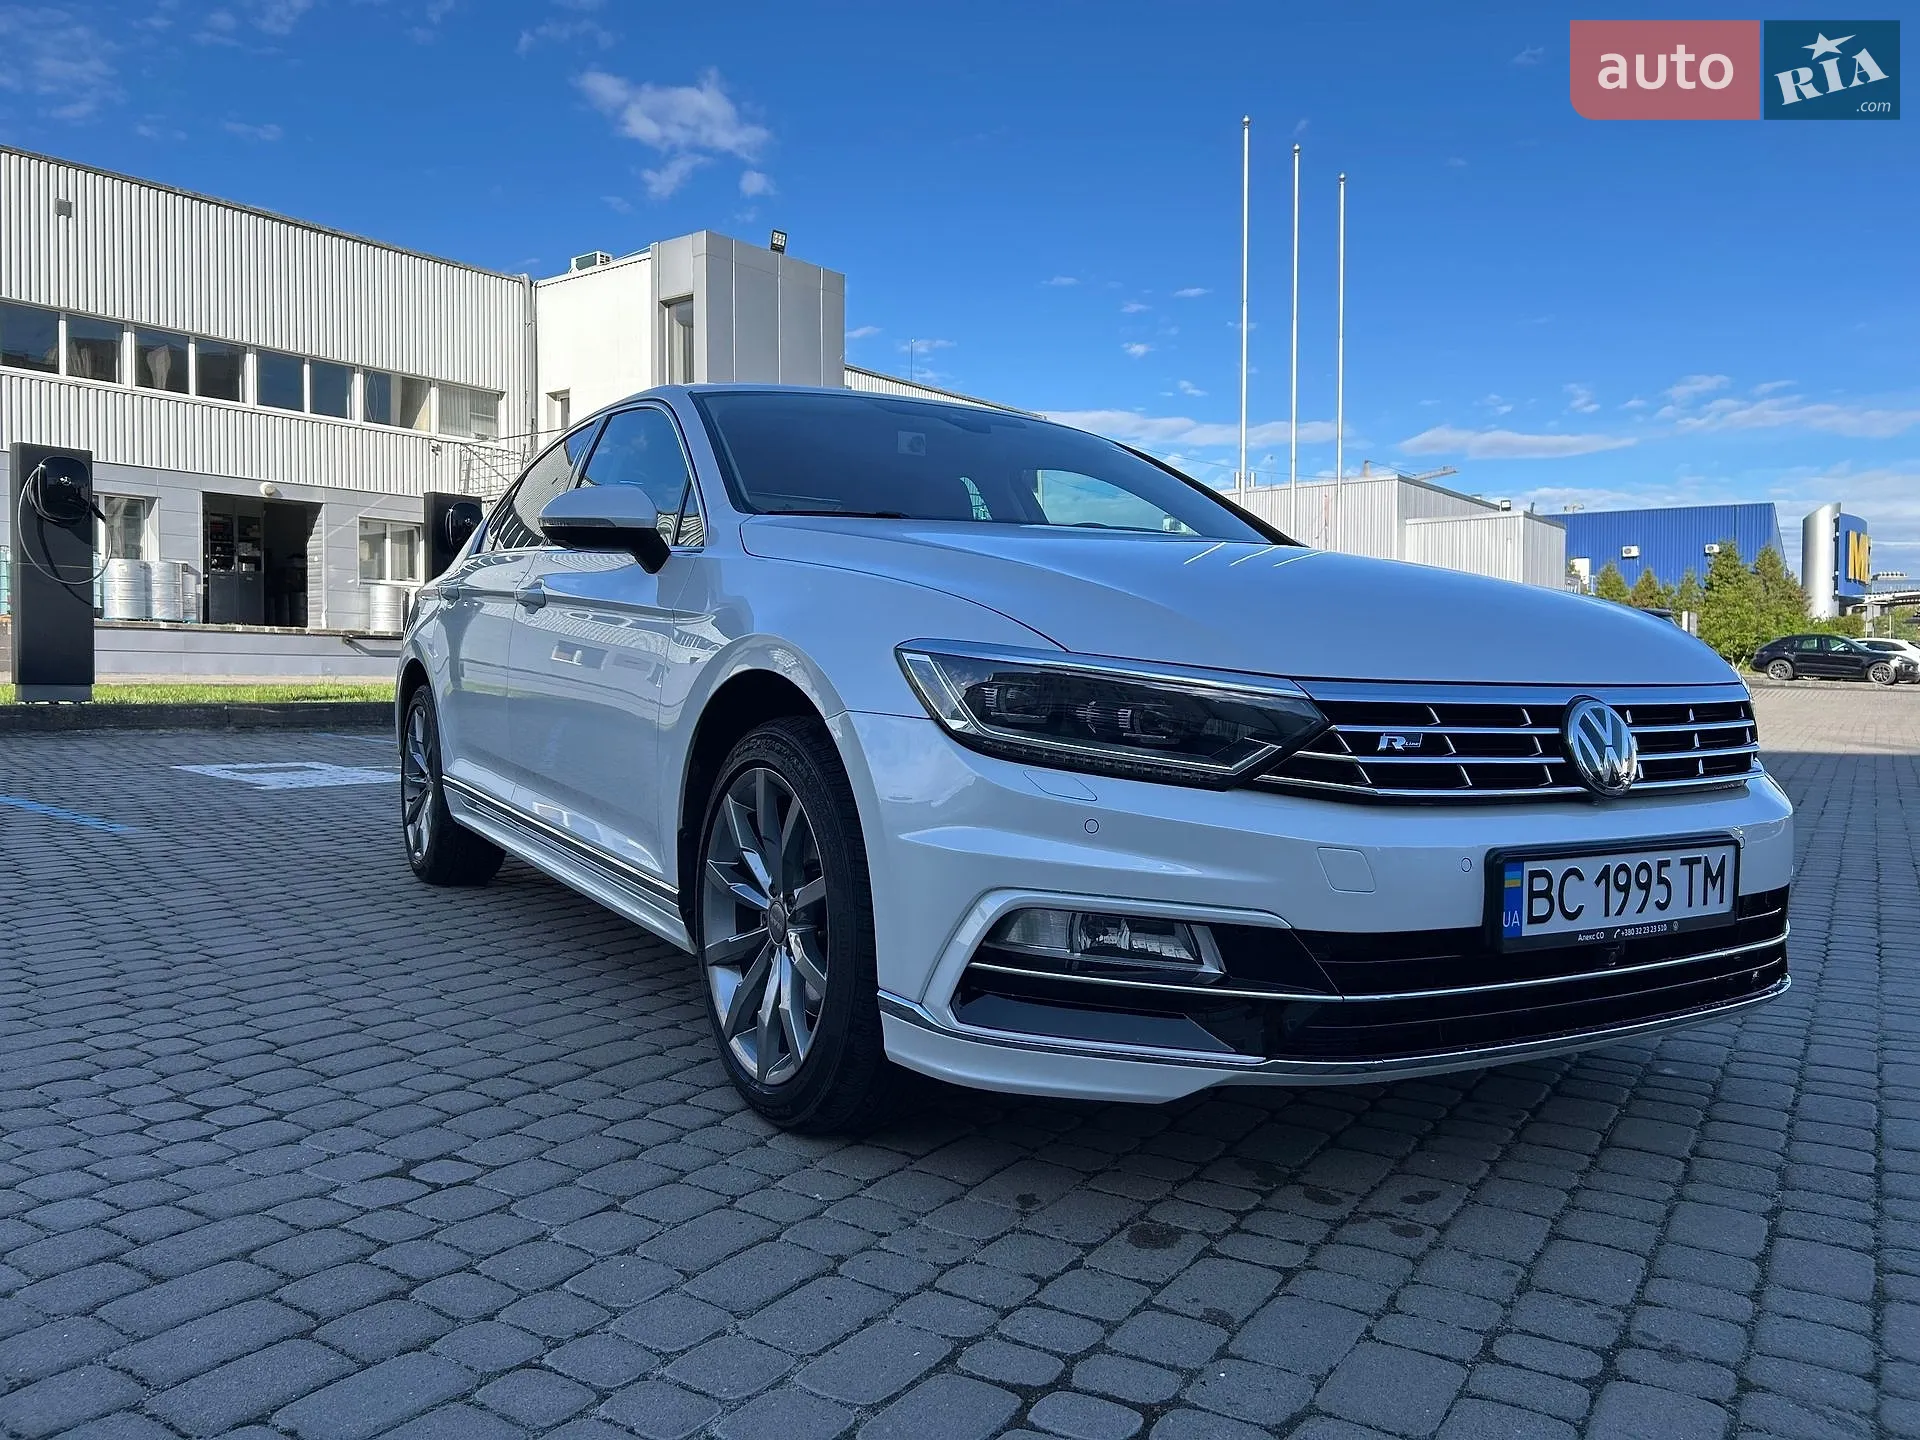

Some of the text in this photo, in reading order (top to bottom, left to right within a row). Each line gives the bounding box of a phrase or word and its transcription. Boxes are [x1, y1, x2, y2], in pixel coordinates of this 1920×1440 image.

[1527, 854, 1726, 925] BC 1995 TM
[1503, 911, 1520, 928] UA
